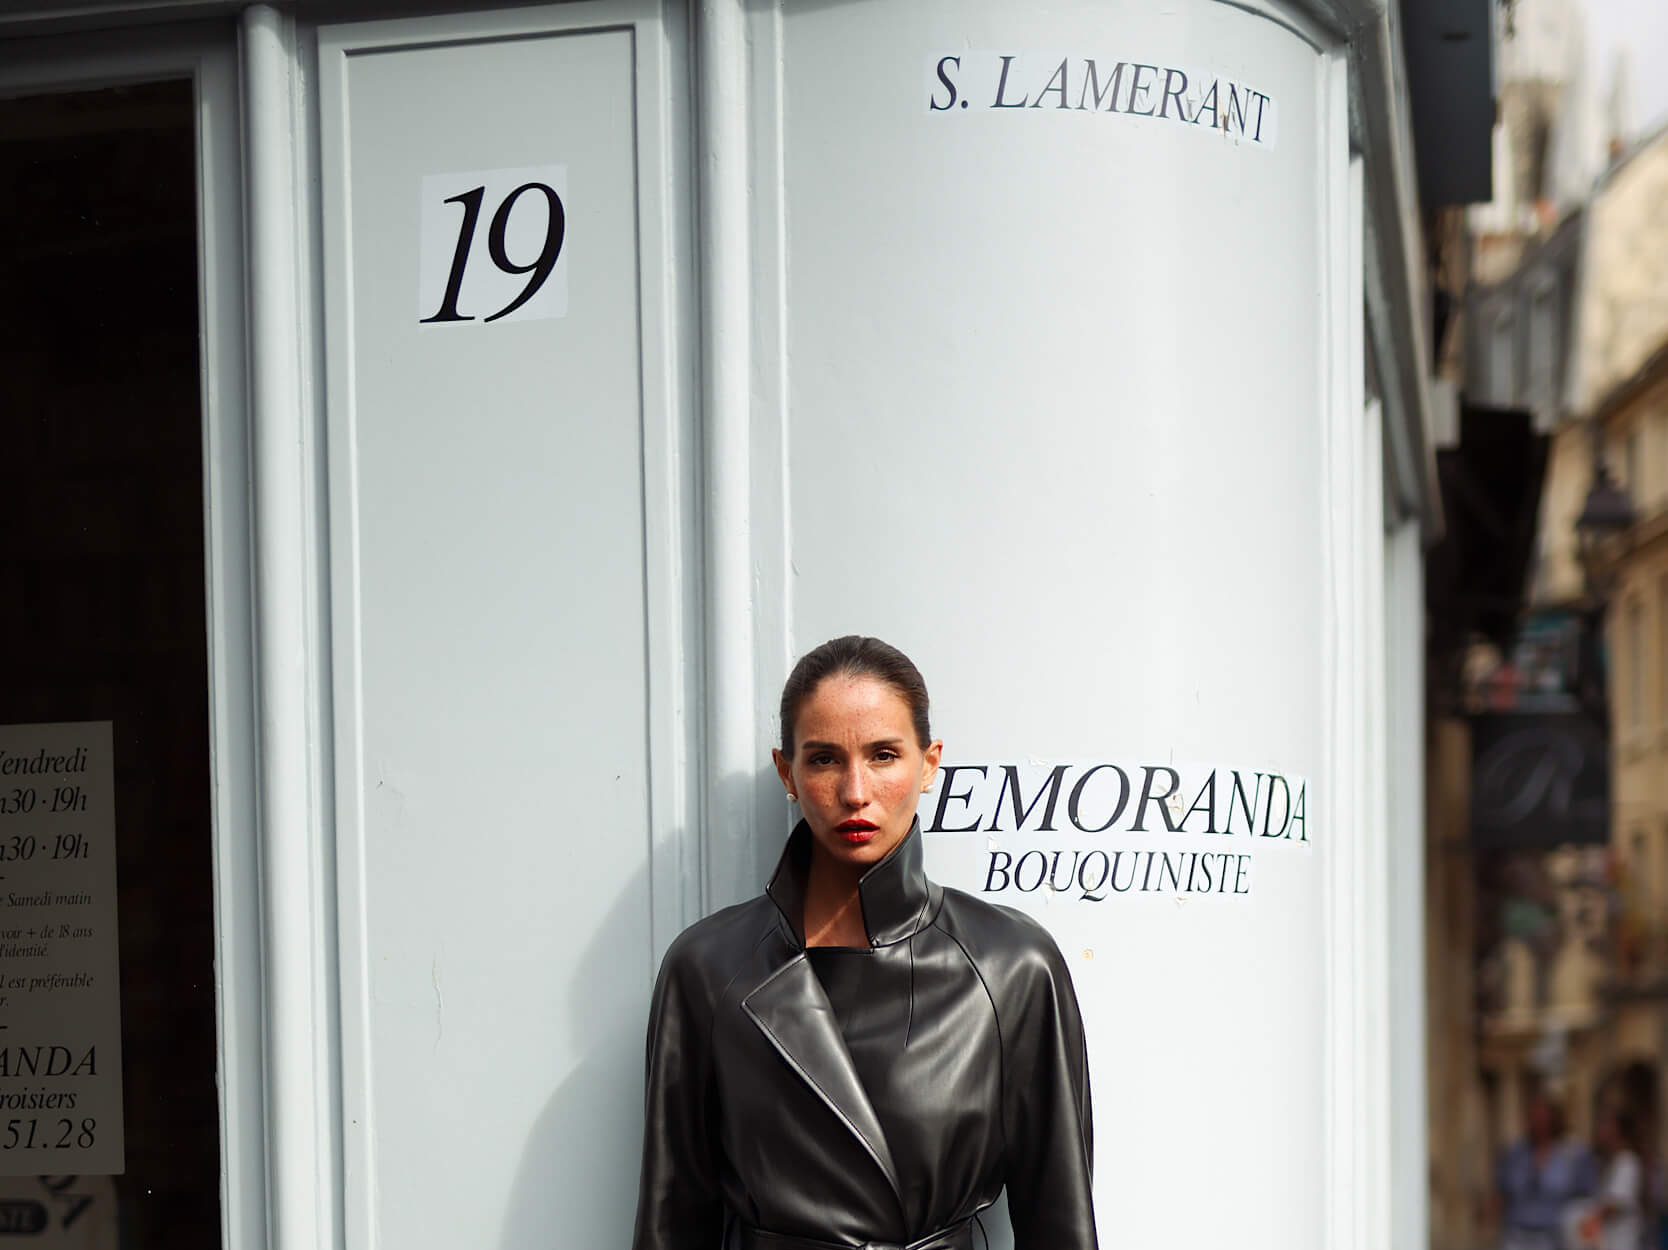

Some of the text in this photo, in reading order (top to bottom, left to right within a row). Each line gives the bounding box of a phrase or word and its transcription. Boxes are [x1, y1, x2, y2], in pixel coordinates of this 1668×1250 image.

[930, 55, 1271, 143] S. LAMERANT
[418, 182, 566, 323] 19
[0, 748, 88, 775] endredi
[923, 764, 1311, 841] EMORANDA
[983, 850, 1252, 902] BOUQUINISTE
[8, 890, 91, 907] Samedi matin
[0, 1087, 77, 1110] roisiers
[3, 1118, 97, 1150] 51.28
